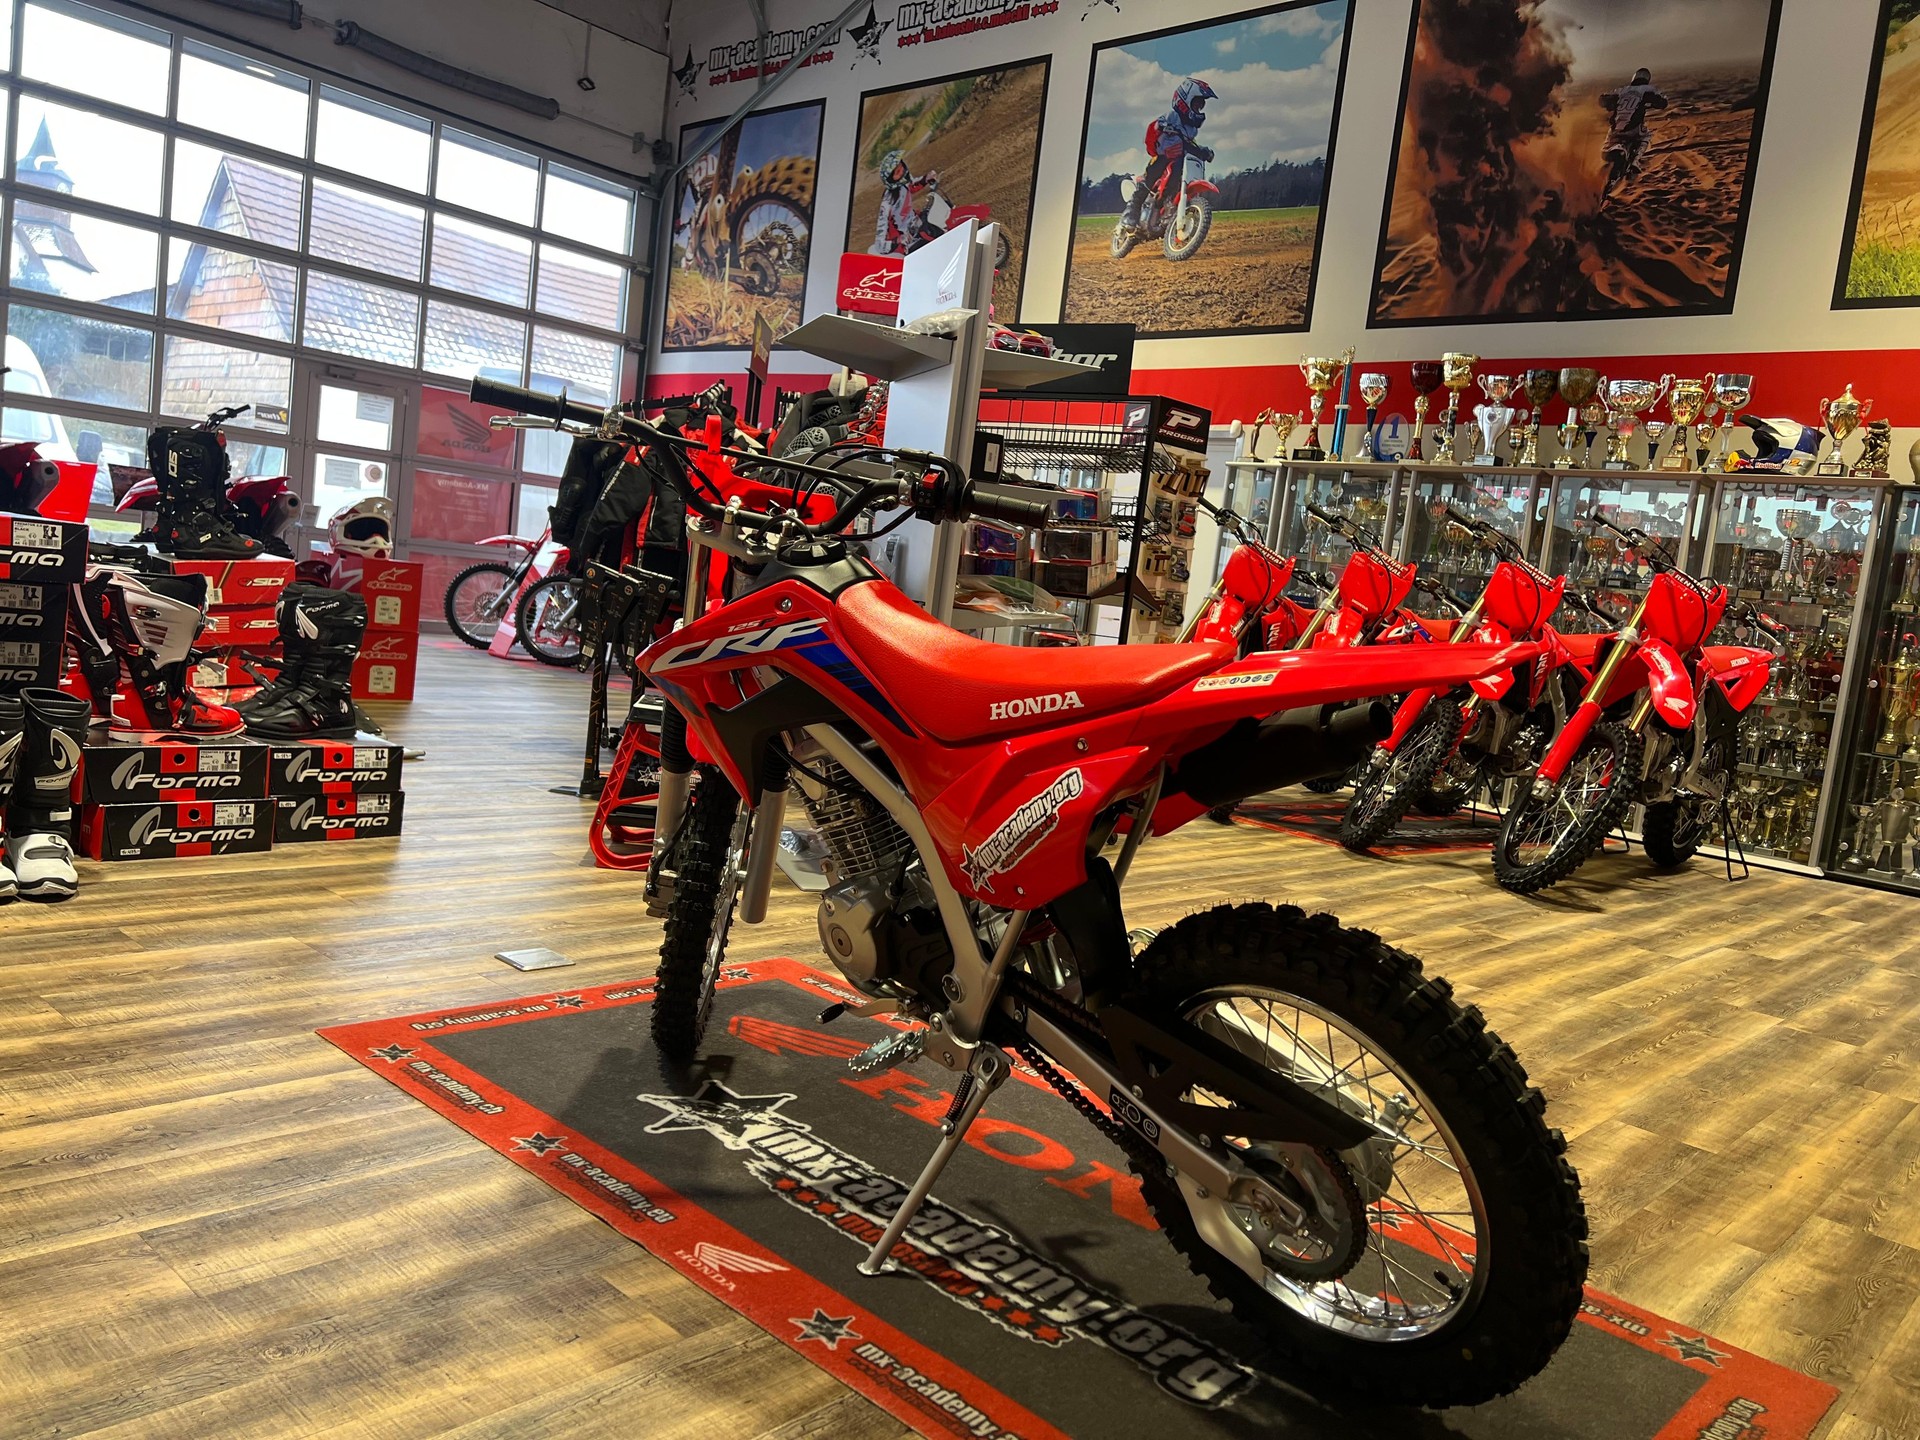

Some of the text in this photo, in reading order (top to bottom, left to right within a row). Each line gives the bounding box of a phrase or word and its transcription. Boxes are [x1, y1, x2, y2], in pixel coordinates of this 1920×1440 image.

[843, 285, 901, 303] alpinesta
[1052, 348, 1118, 368] hor
[1158, 428, 1205, 444] PROGRIP
[251, 577, 285, 587] SIDI
[248, 619, 277, 629] SID
[650, 617, 829, 674] CRF
[989, 690, 1085, 721] HONDA
[126, 773, 242, 790] Forma
[298, 769, 388, 783] Forma
[302, 815, 389, 831] Forma
[978, 770, 1083, 869] mx-academy.org
[142, 828, 256, 845] Forma
[410, 1003, 551, 1032] mx-academy.org
[408, 1060, 506, 1116] mx-academy.ch
[838, 1067, 1163, 1232] HON
[559, 1152, 677, 1224] mx-academy.eu
[674, 1249, 738, 1292] HONDA
[757, 1126, 1246, 1406] mx-academy.org
[852, 1342, 1024, 1440] mx-academy.
